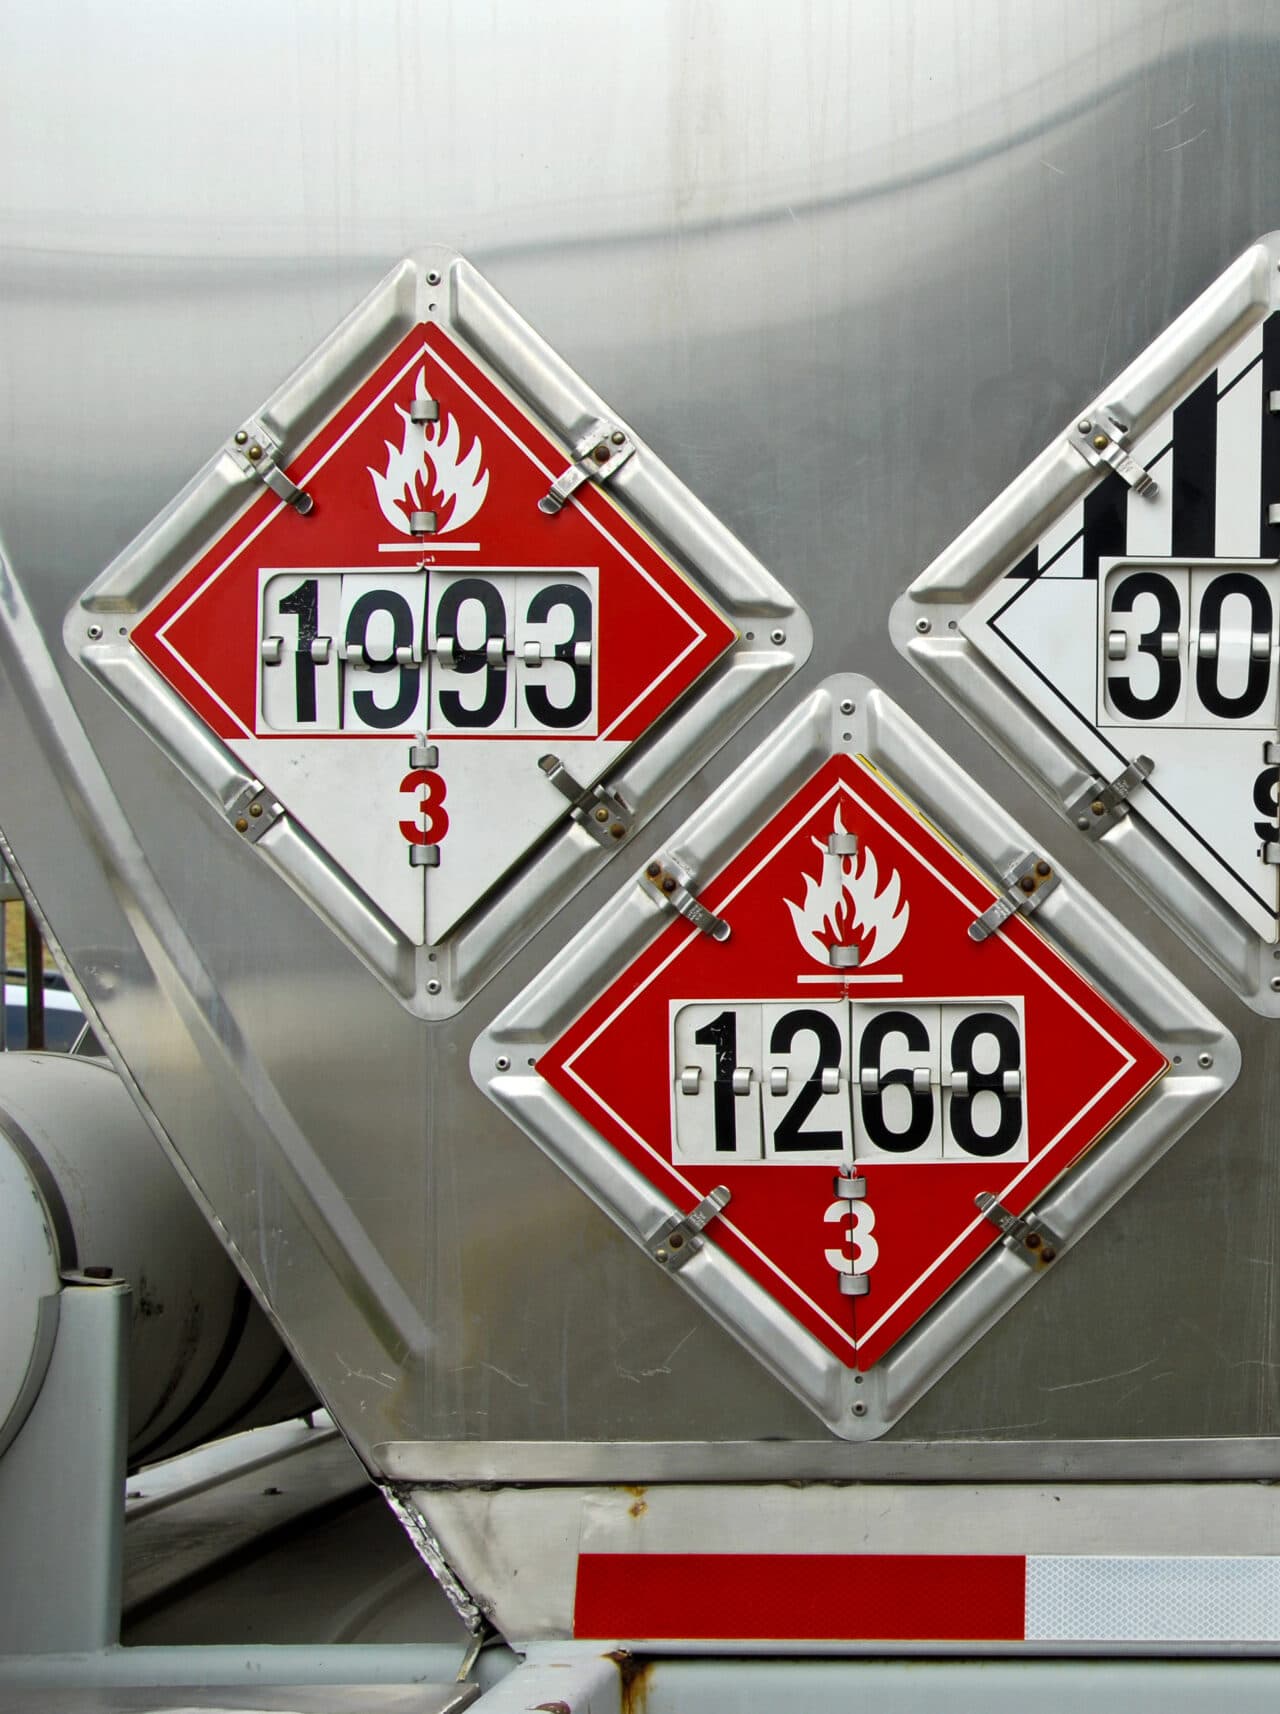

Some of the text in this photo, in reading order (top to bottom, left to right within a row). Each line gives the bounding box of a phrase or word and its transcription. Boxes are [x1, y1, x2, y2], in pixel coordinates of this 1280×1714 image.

[277, 578, 591, 729] 1993
[398, 770, 449, 845] 3
[695, 1010, 1023, 1157] 1268
[824, 1200, 879, 1274] 3
